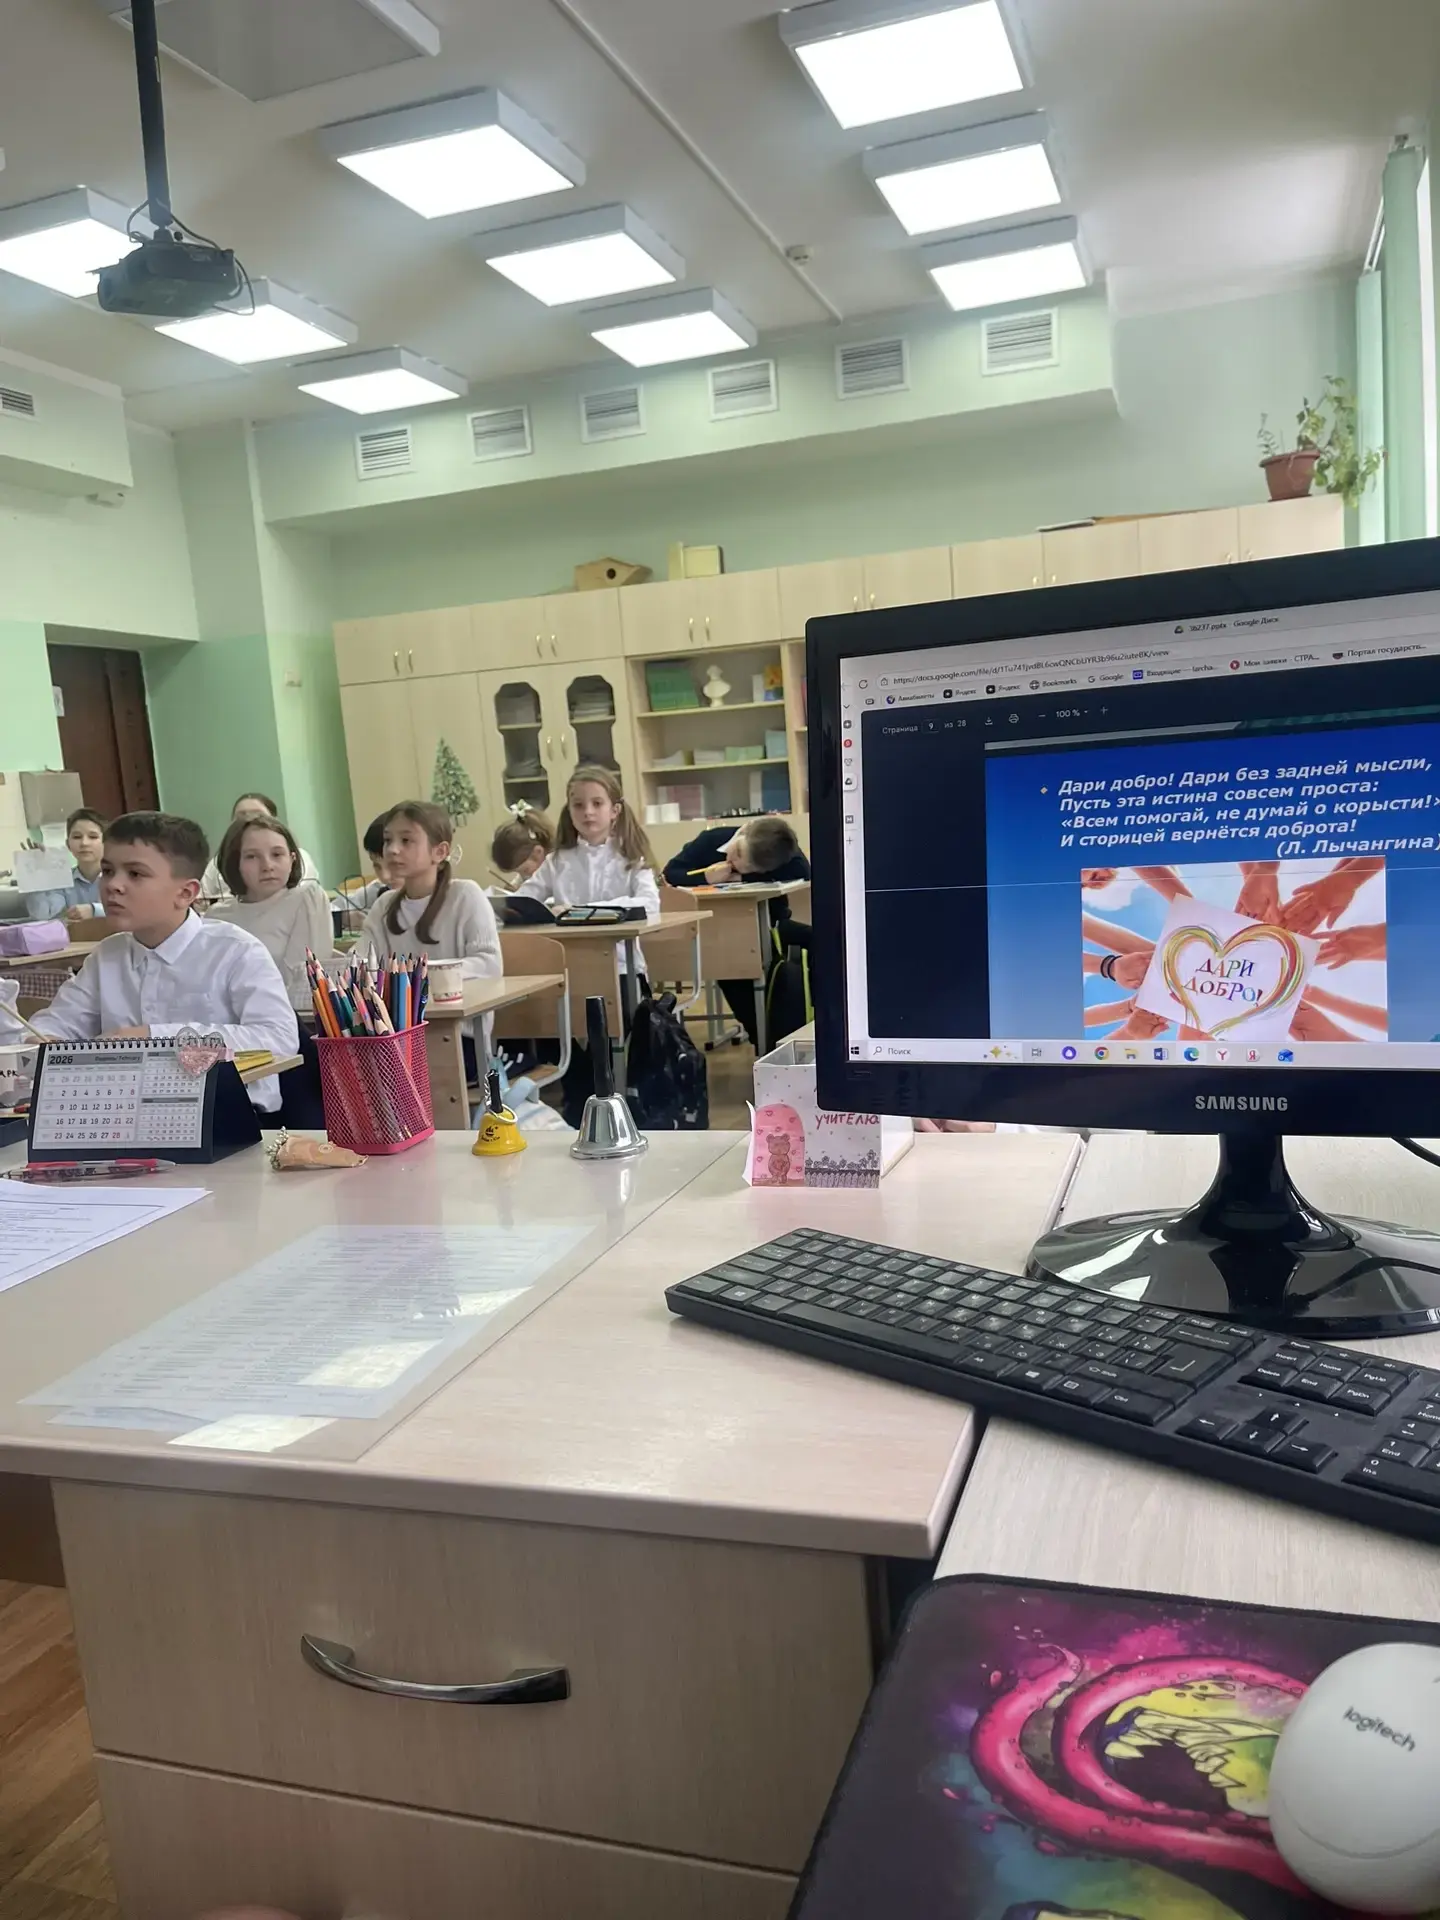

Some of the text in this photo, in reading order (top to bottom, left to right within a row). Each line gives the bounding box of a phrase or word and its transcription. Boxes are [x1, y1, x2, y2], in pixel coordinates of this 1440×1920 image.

[1233, 619, 1259, 628] Google
[1260, 617, 1279, 625] Диск
[1347, 648, 1376, 657] Портал
[1042, 678, 1077, 688] Bookmarks
[1099, 673, 1124, 683] Google
[1056, 710, 1071, 718] 100
[882, 725, 919, 735] Страница
[1058, 757, 1433, 796] Дари добро! Дари без задней мысли,
[1060, 780, 1379, 813] Пусть эта истина совсем проста:
[1061, 815, 1118, 829] «Всем
[1124, 808, 1210, 826] помогай,
[1216, 808, 1241, 820] не
[1244, 801, 1308, 821] думай
[1314, 803, 1327, 815] о
[1060, 819, 1357, 848] И сторицей вернётся доброта!
[1276, 833, 1440, 858] (Л. Лычангина)
[1194, 958, 1256, 979] ДАРИ
[1181, 976, 1264, 1008] ДОБРО!
[887, 1048, 912, 1056] Поиск
[49, 1055, 74, 1065] 2026
[1195, 1095, 1288, 1112] SAMSUNG
[1257, 1367, 1281, 1377] Delete
[1319, 1362, 1342, 1372] Home
[1301, 1378, 1319, 1387] End
[1364, 1373, 1387, 1382] PgUp
[1347, 1389, 1370, 1399] PgDn
[1381, 1448, 1401, 1457] End
[1343, 1706, 1415, 1752] logitech
